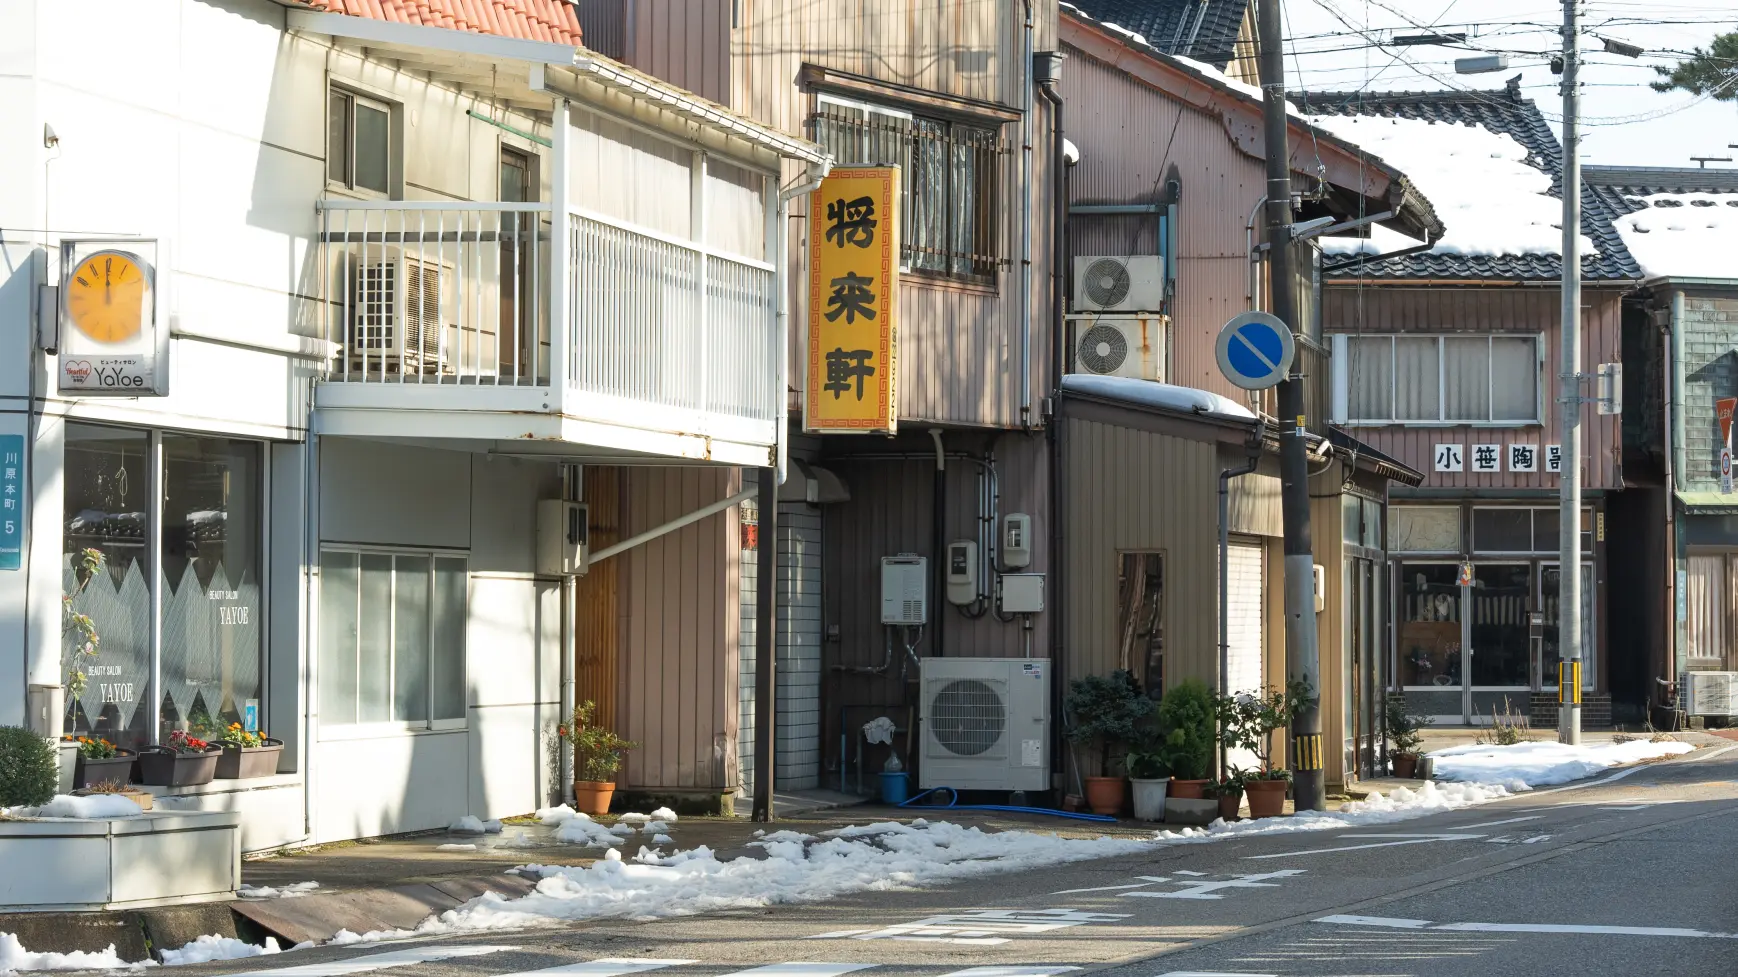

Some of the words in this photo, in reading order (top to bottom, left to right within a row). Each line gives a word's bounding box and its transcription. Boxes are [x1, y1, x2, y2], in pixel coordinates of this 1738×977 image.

[824, 195, 878, 402] 将来軒
[94, 366, 144, 387] YaYoe
[4, 452, 18, 511] 川原本町
[5, 520, 15, 534] 5
[209, 590, 225, 600] BEAUTY
[225, 590, 239, 600] SALON
[219, 606, 249, 625] YAYOE
[88, 665, 106, 676] BEAUTY
[106, 665, 122, 676] SALON
[100, 683, 134, 703] YAYOE
